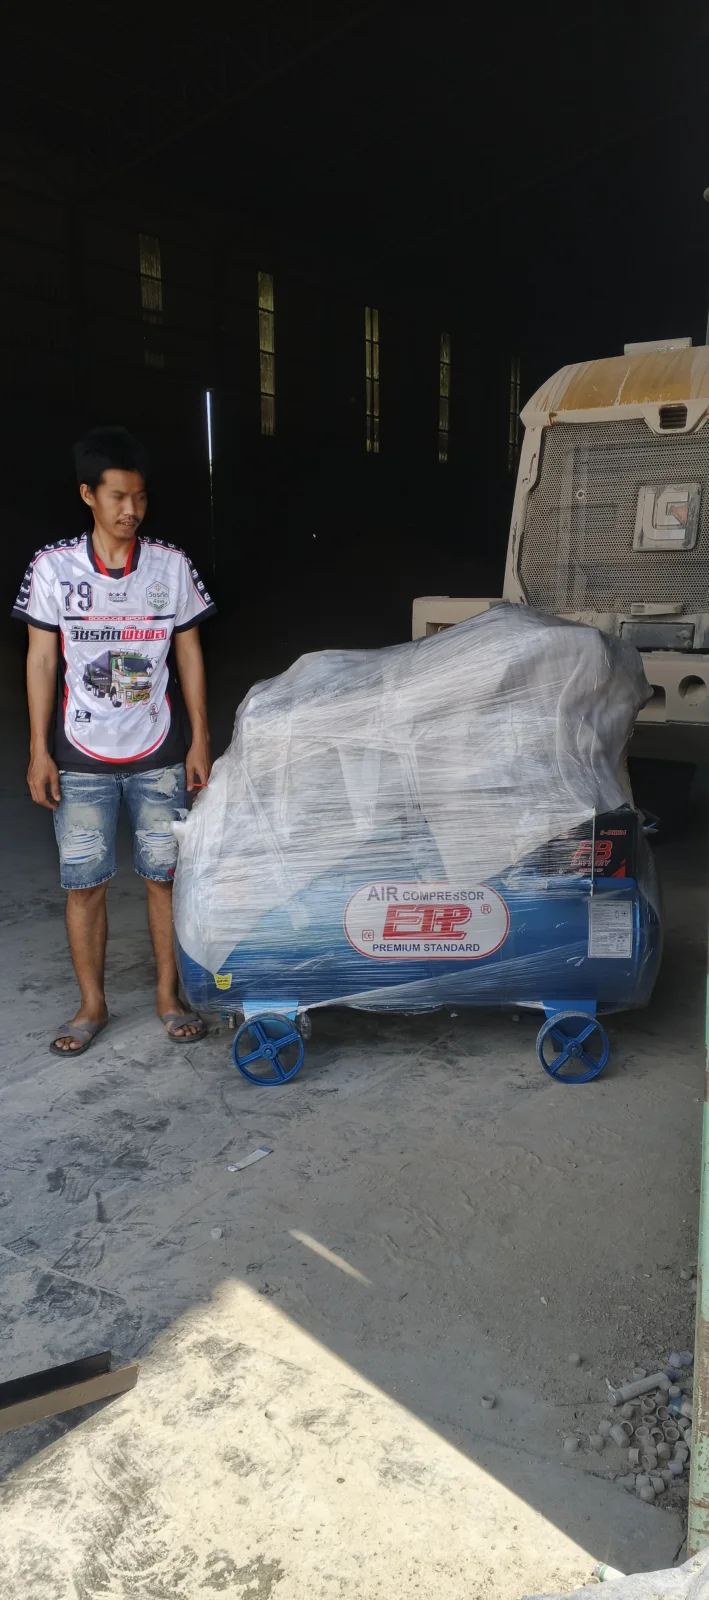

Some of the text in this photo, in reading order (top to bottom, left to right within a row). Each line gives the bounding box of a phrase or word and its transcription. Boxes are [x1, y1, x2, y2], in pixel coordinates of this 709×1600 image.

[60, 581, 93, 612] 79
[366, 886, 485, 902] AIR COMPRESSOR
[372, 944, 480, 952] PREMIUM STANDARD
